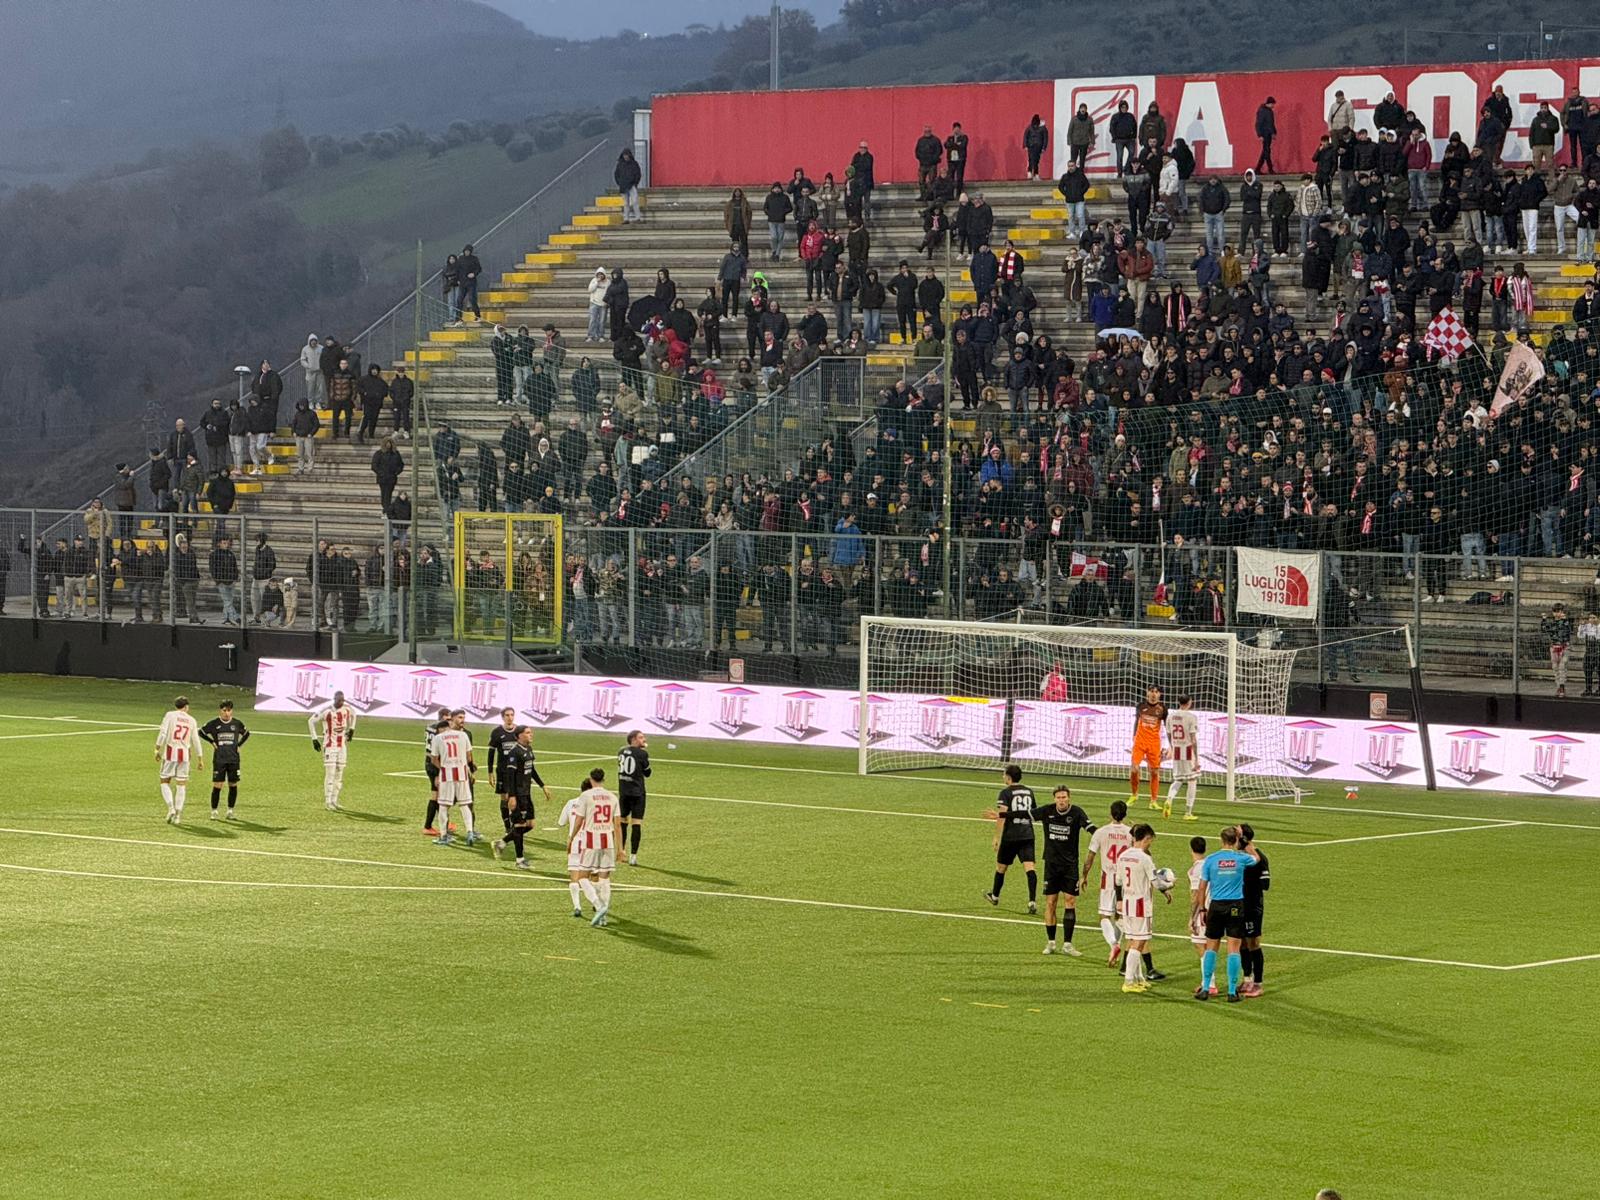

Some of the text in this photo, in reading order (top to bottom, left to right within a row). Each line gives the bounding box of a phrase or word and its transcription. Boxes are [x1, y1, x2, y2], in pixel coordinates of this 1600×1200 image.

[1168, 81, 1233, 168] A
[1274, 565, 1286, 577] 15
[1244, 574, 1285, 591] LUGLIO
[1261, 591, 1285, 604] 1913
[174, 725, 189, 740] 27
[1172, 724, 1185, 740] 23
[447, 742, 458, 758] 11
[593, 805, 611, 823] 29
[1125, 867, 1131, 887] 3
[1245, 922, 1254, 930] 13
